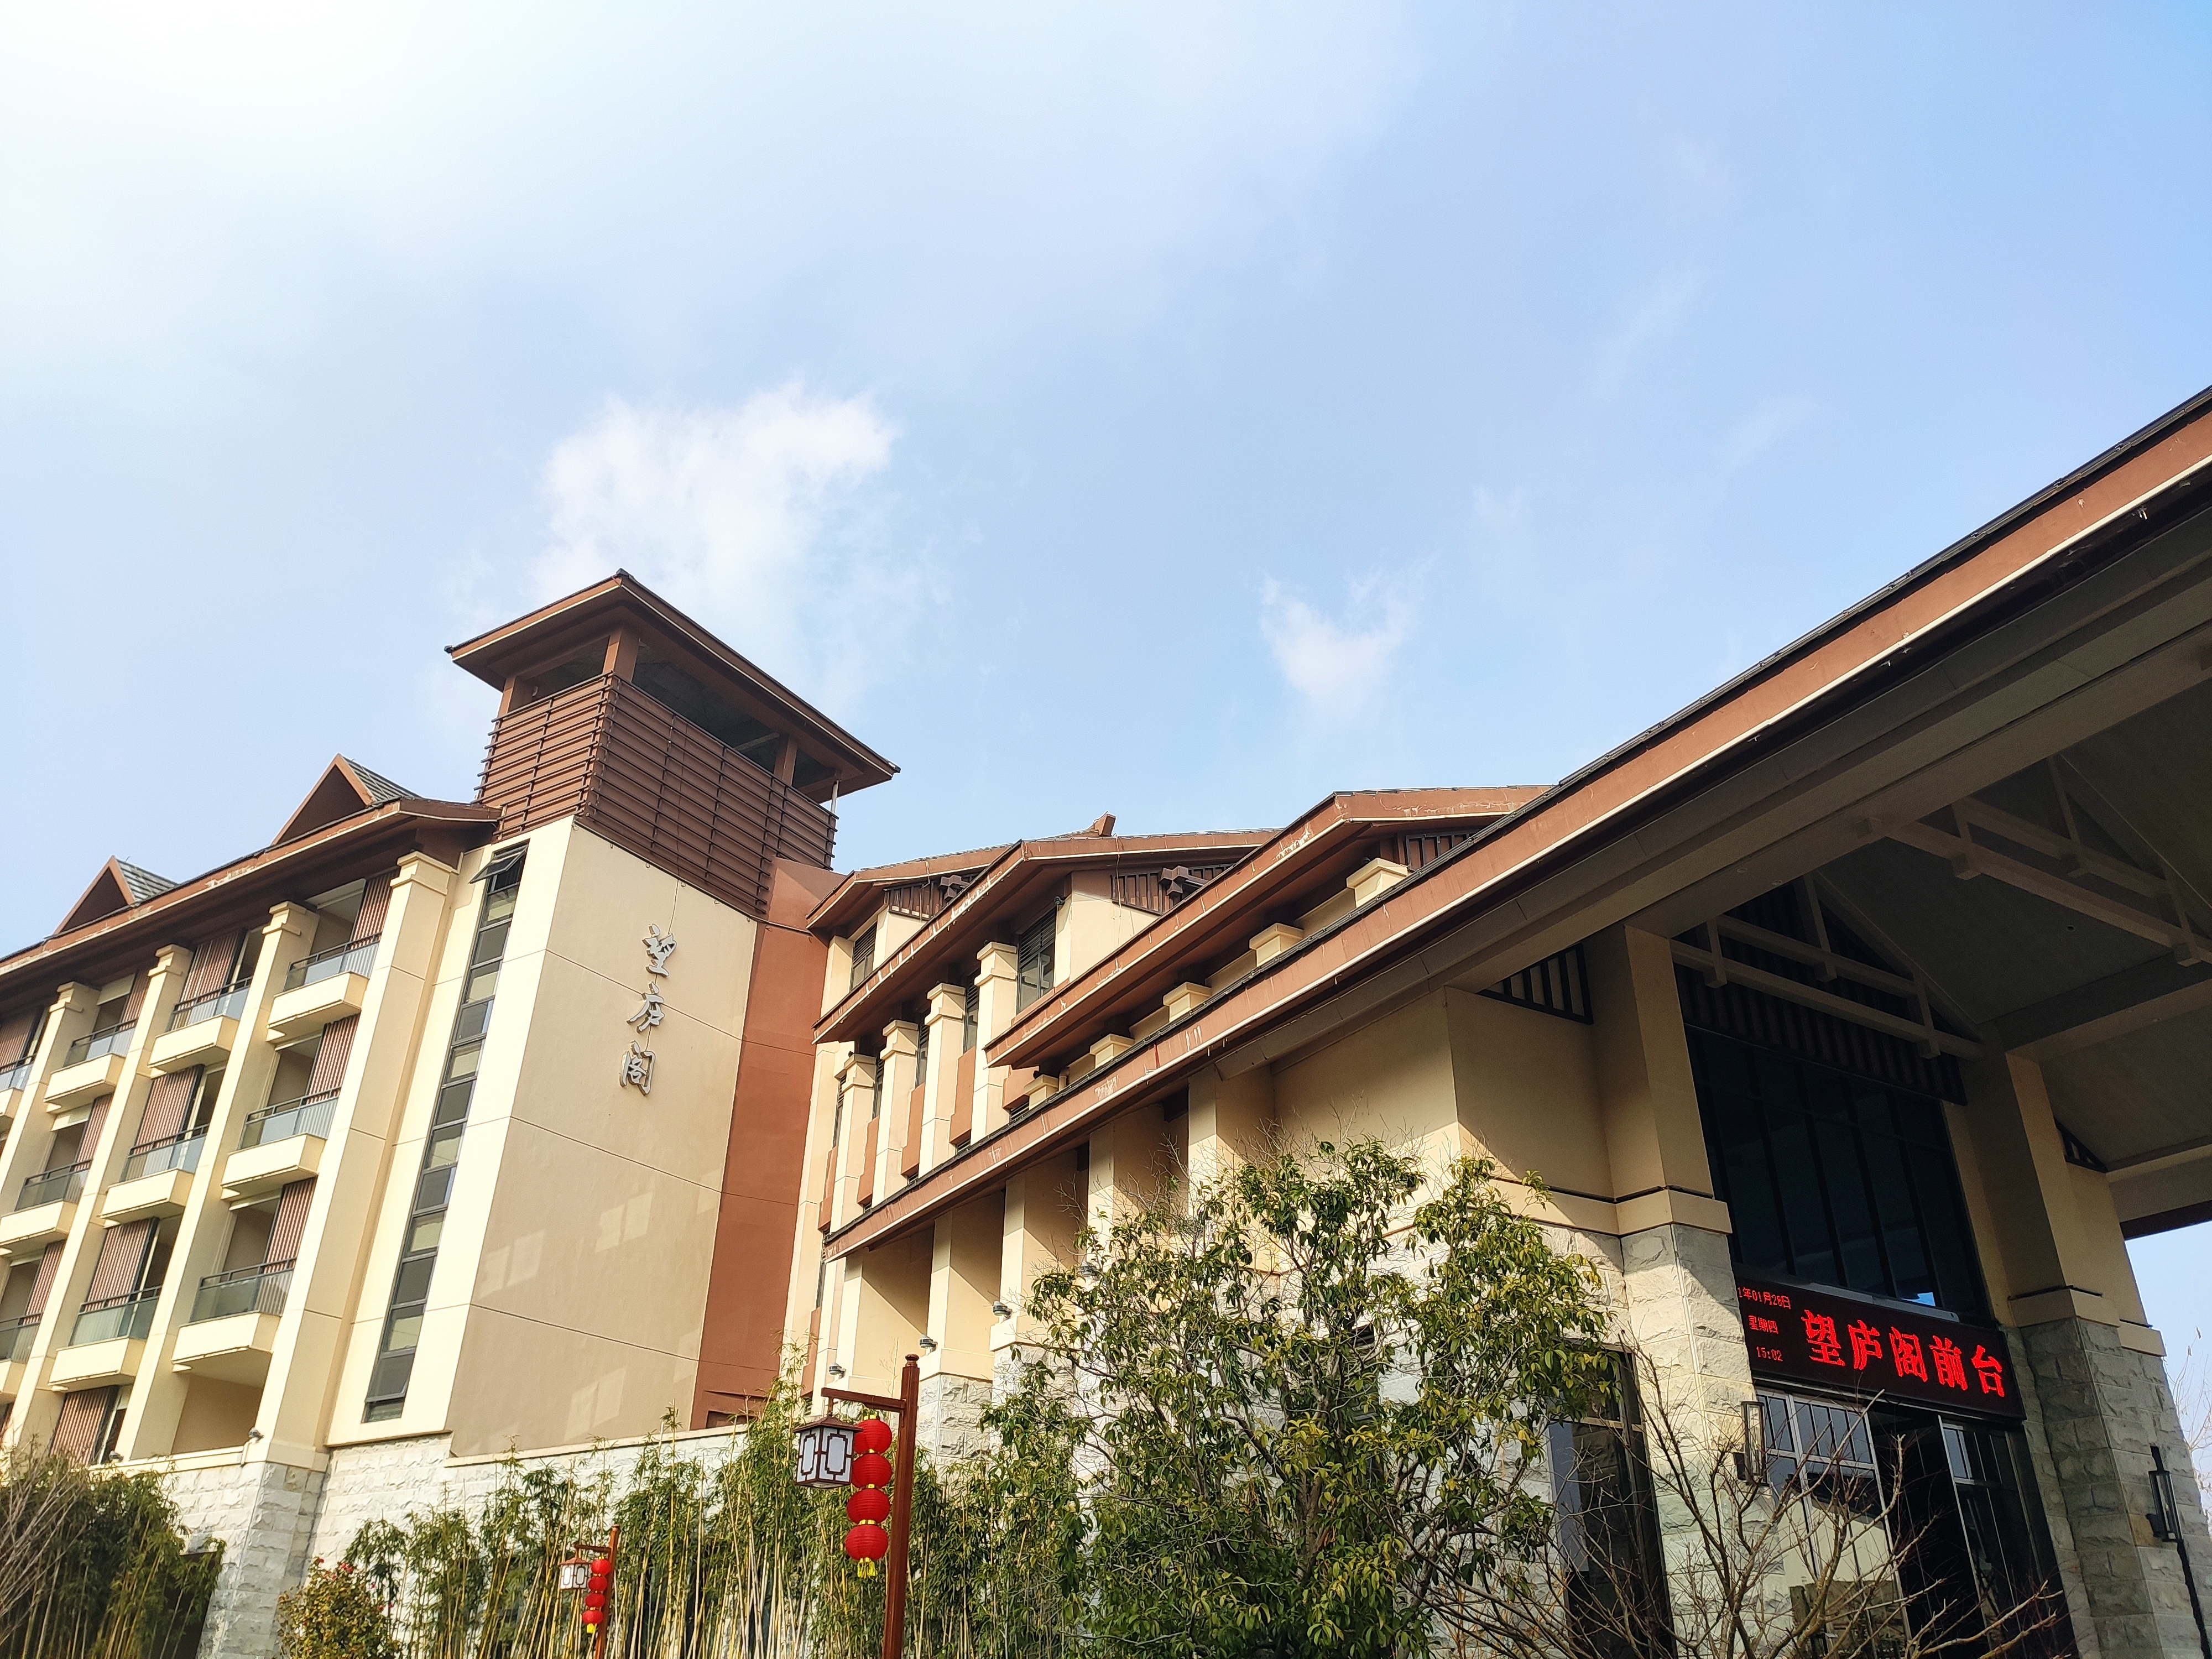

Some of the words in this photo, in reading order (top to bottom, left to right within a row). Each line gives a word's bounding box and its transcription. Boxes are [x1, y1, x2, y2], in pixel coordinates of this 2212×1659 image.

[1748, 1314, 1779, 1334] 星期四
[1755, 1345, 1783, 1362] 15:02
[1801, 1309, 2006, 1397] 望庐阁前台
